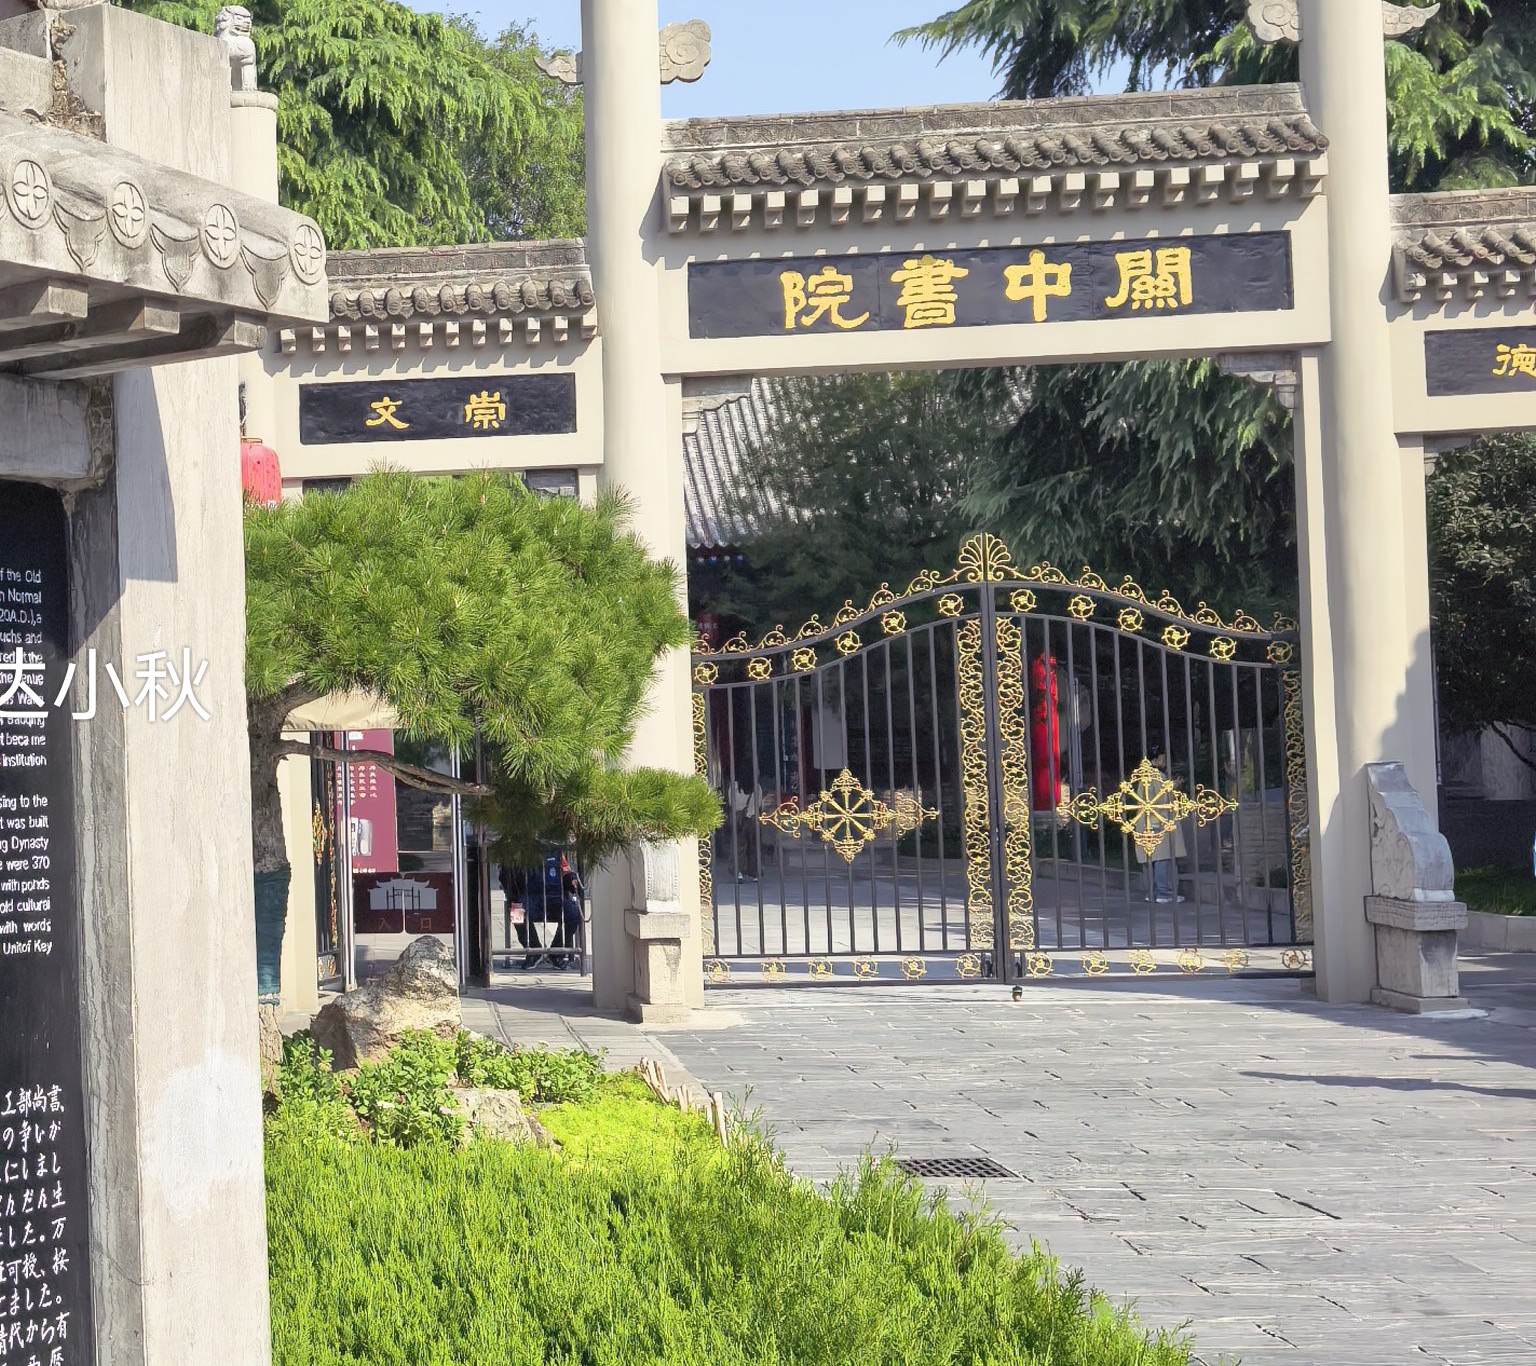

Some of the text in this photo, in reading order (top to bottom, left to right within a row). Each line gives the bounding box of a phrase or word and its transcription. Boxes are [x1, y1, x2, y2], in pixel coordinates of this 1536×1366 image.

[8, 589, 41, 603] Normal
[7, 819, 25, 829] was
[29, 815, 49, 828] built
[12, 836, 49, 852] Dynasty
[6, 860, 29, 870] were
[32, 856, 50, 869] 370
[0, 899, 13, 913] old
[0, 921, 17, 934] with
[24, 918, 51, 932] words
[34, 940, 52, 954] Key
